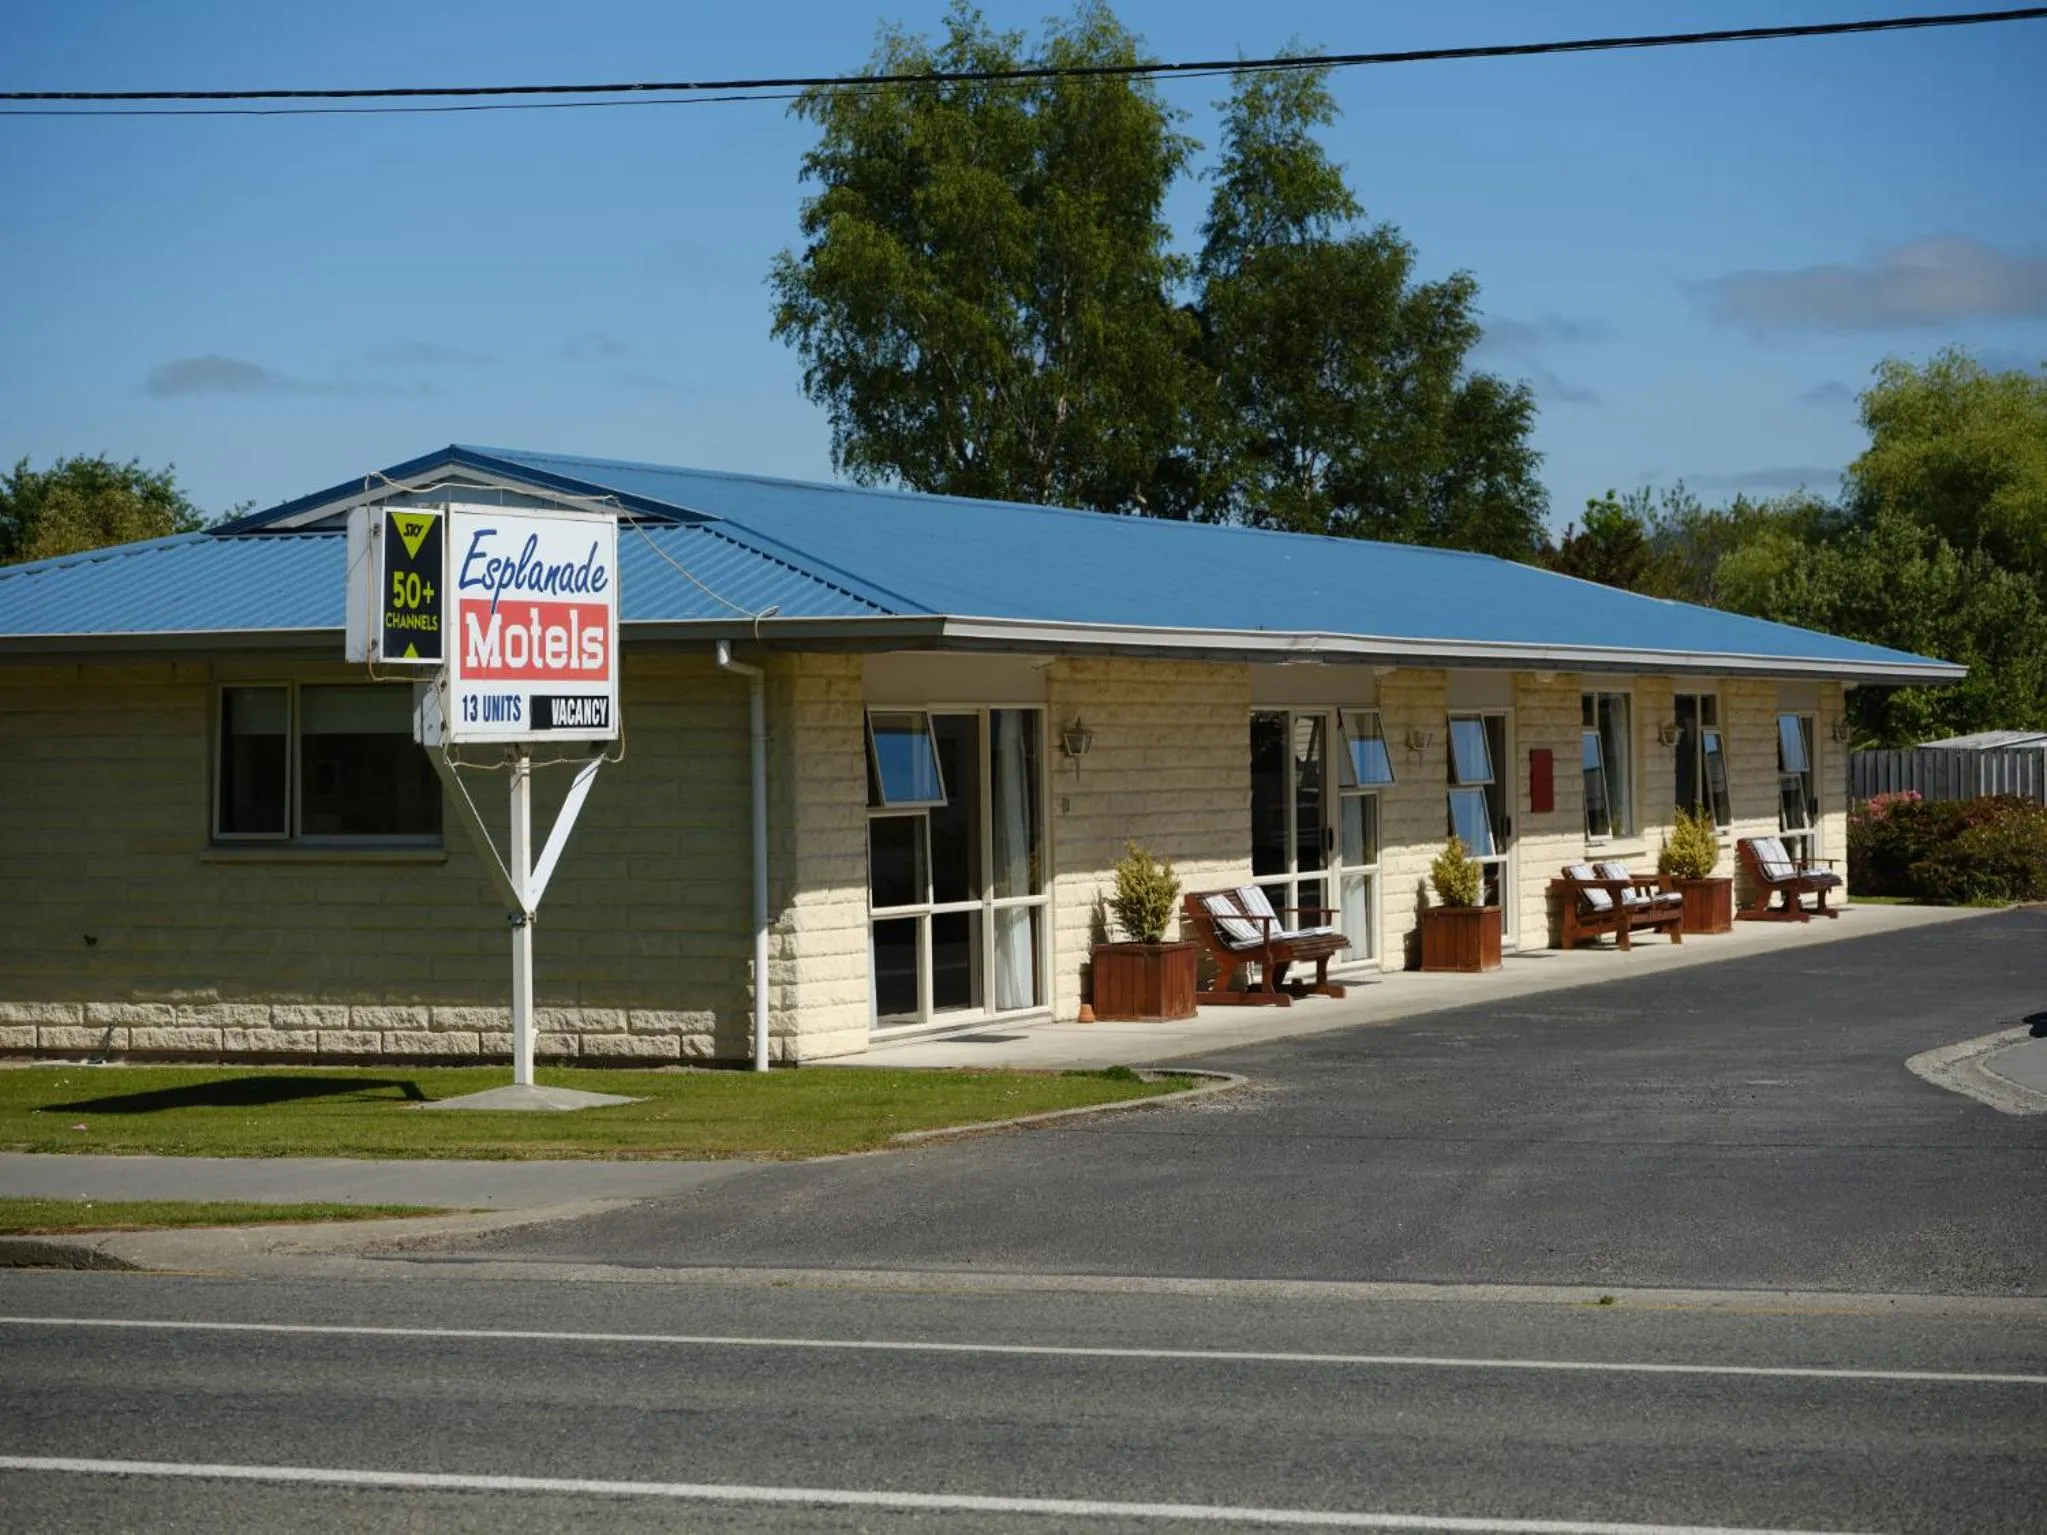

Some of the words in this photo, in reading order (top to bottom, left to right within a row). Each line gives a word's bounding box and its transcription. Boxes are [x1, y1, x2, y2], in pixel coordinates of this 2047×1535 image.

[458, 528, 608, 614] Esplanade
[392, 571, 435, 609] 50+
[385, 612, 438, 632] CHANNELS
[464, 608, 606, 670] Motels
[462, 695, 478, 722] 13
[483, 694, 522, 722] UNITS
[551, 698, 608, 726] VACANCY
